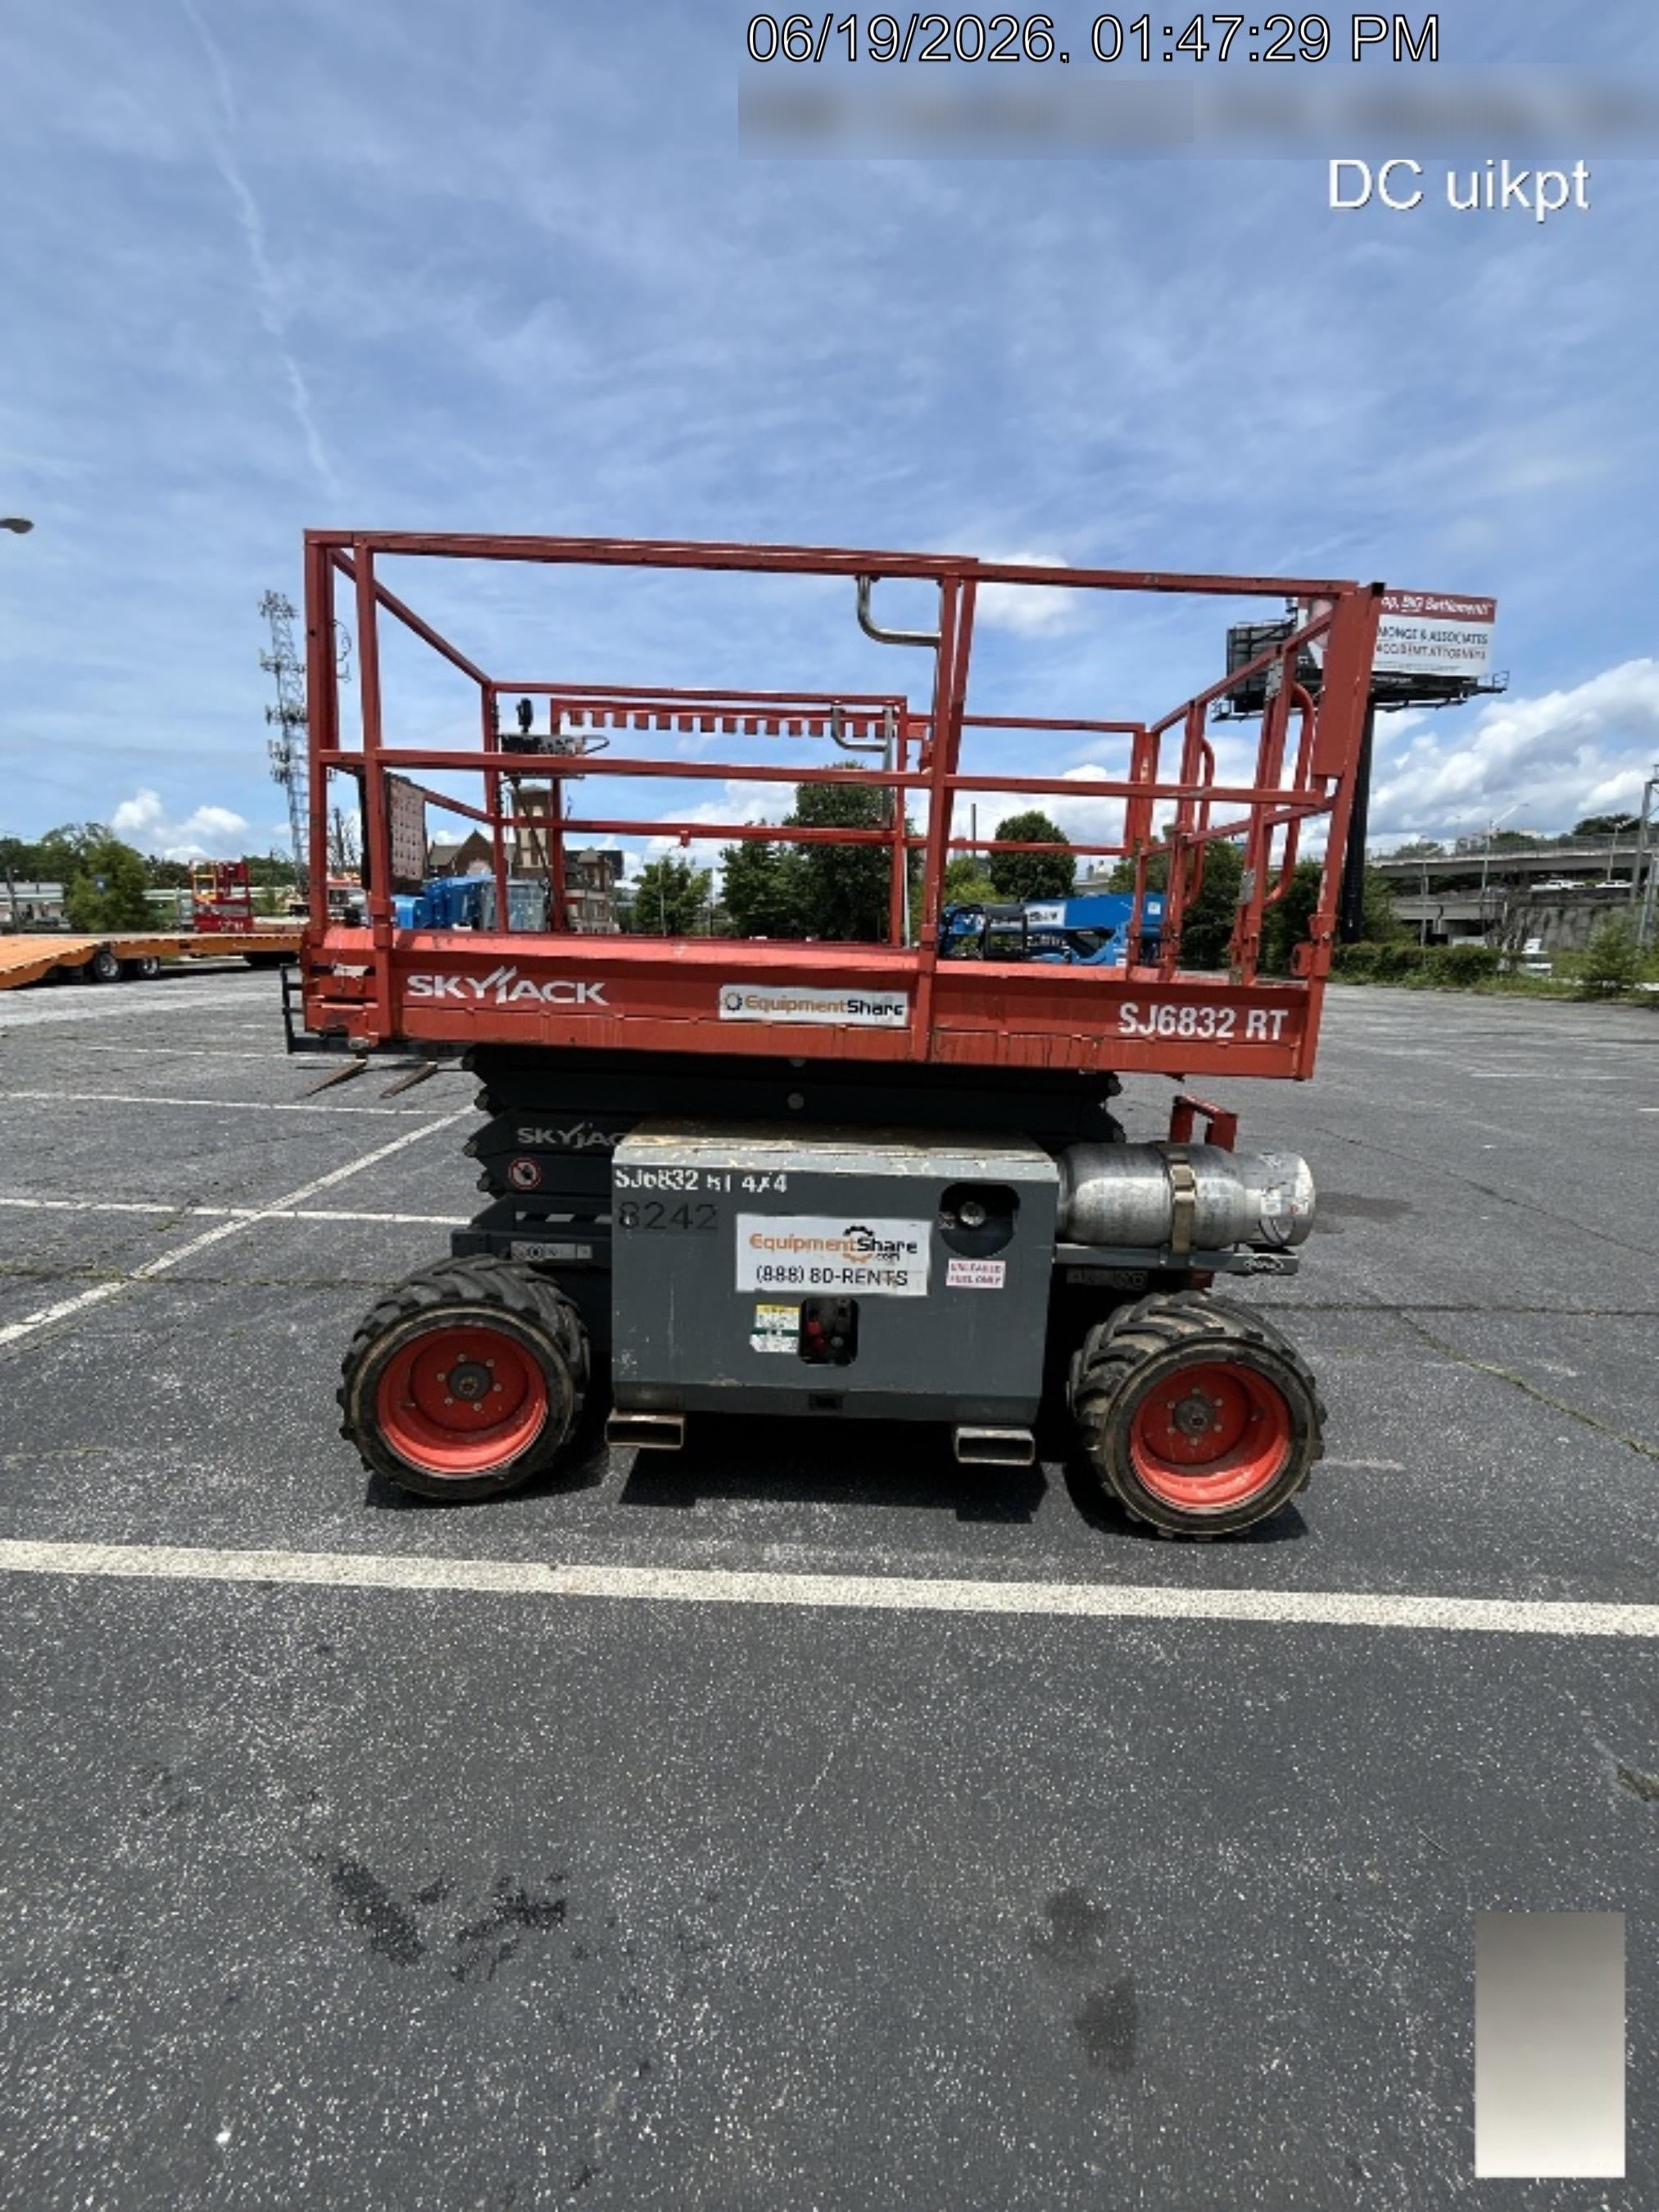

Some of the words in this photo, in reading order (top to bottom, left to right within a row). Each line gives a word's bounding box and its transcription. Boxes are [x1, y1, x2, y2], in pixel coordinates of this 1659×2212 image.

[1430, 630, 1489, 645] ASSOCIATES
[407, 965, 610, 1006] SKYJACK
[1118, 1001, 1237, 1039] SJ6832
[1245, 1009, 1289, 1040] RT
[517, 1121, 628, 1149] SKYJAC
[619, 1200, 719, 1230] 8242
[749, 1232, 918, 1254] EquipmentShare
[756, 1264, 805, 1284] (888)
